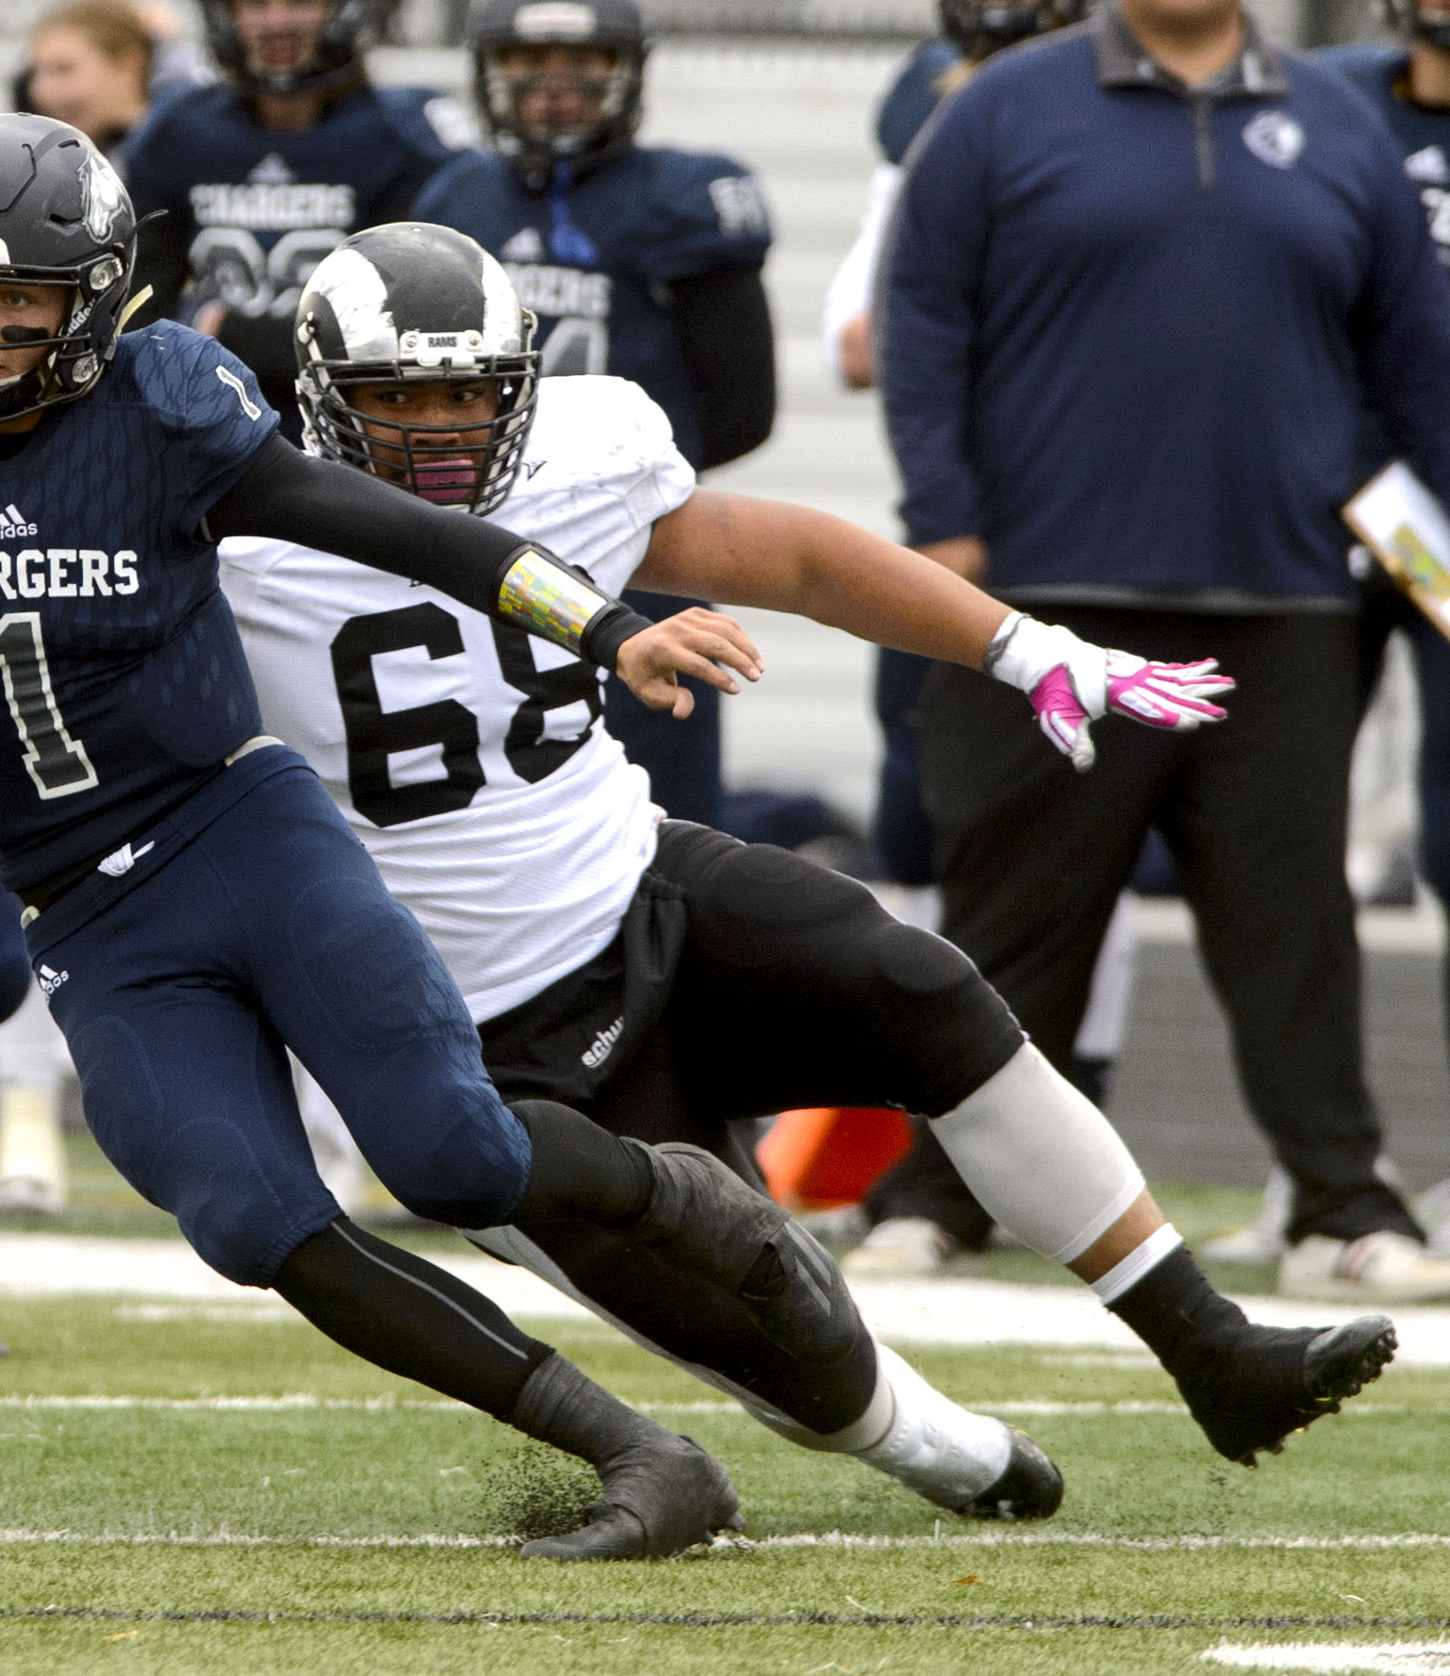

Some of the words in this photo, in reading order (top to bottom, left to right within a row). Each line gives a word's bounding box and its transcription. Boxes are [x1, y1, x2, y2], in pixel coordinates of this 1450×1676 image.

[428, 336, 458, 348] RAMS
[215, 363, 262, 421] 1
[330, 601, 604, 828] 68
